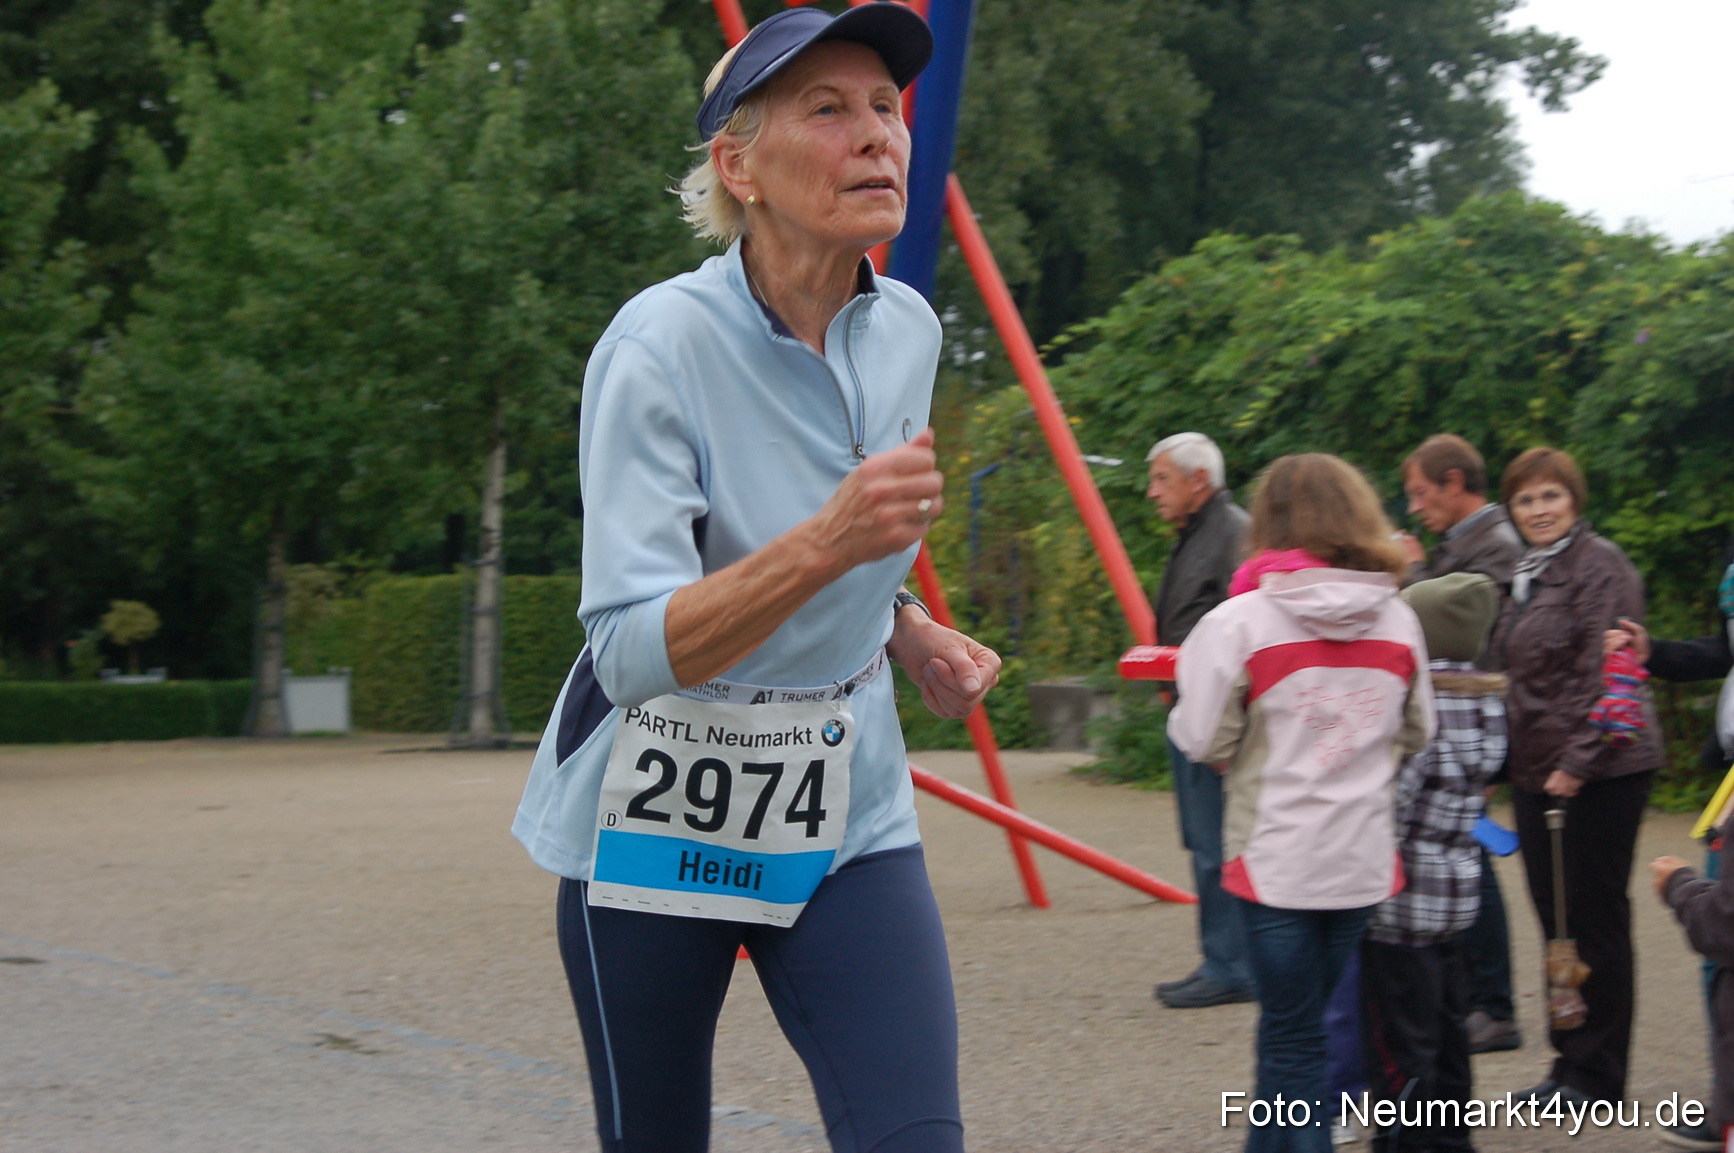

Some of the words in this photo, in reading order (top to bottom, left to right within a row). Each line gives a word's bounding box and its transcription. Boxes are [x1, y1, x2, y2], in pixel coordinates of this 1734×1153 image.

[781, 691, 826, 702] TRUMER
[624, 706, 699, 743] PARTL
[705, 725, 813, 748] Neumarkt
[625, 748, 827, 840] 2974
[606, 813, 617, 827] D
[678, 850, 764, 891] Heidi
